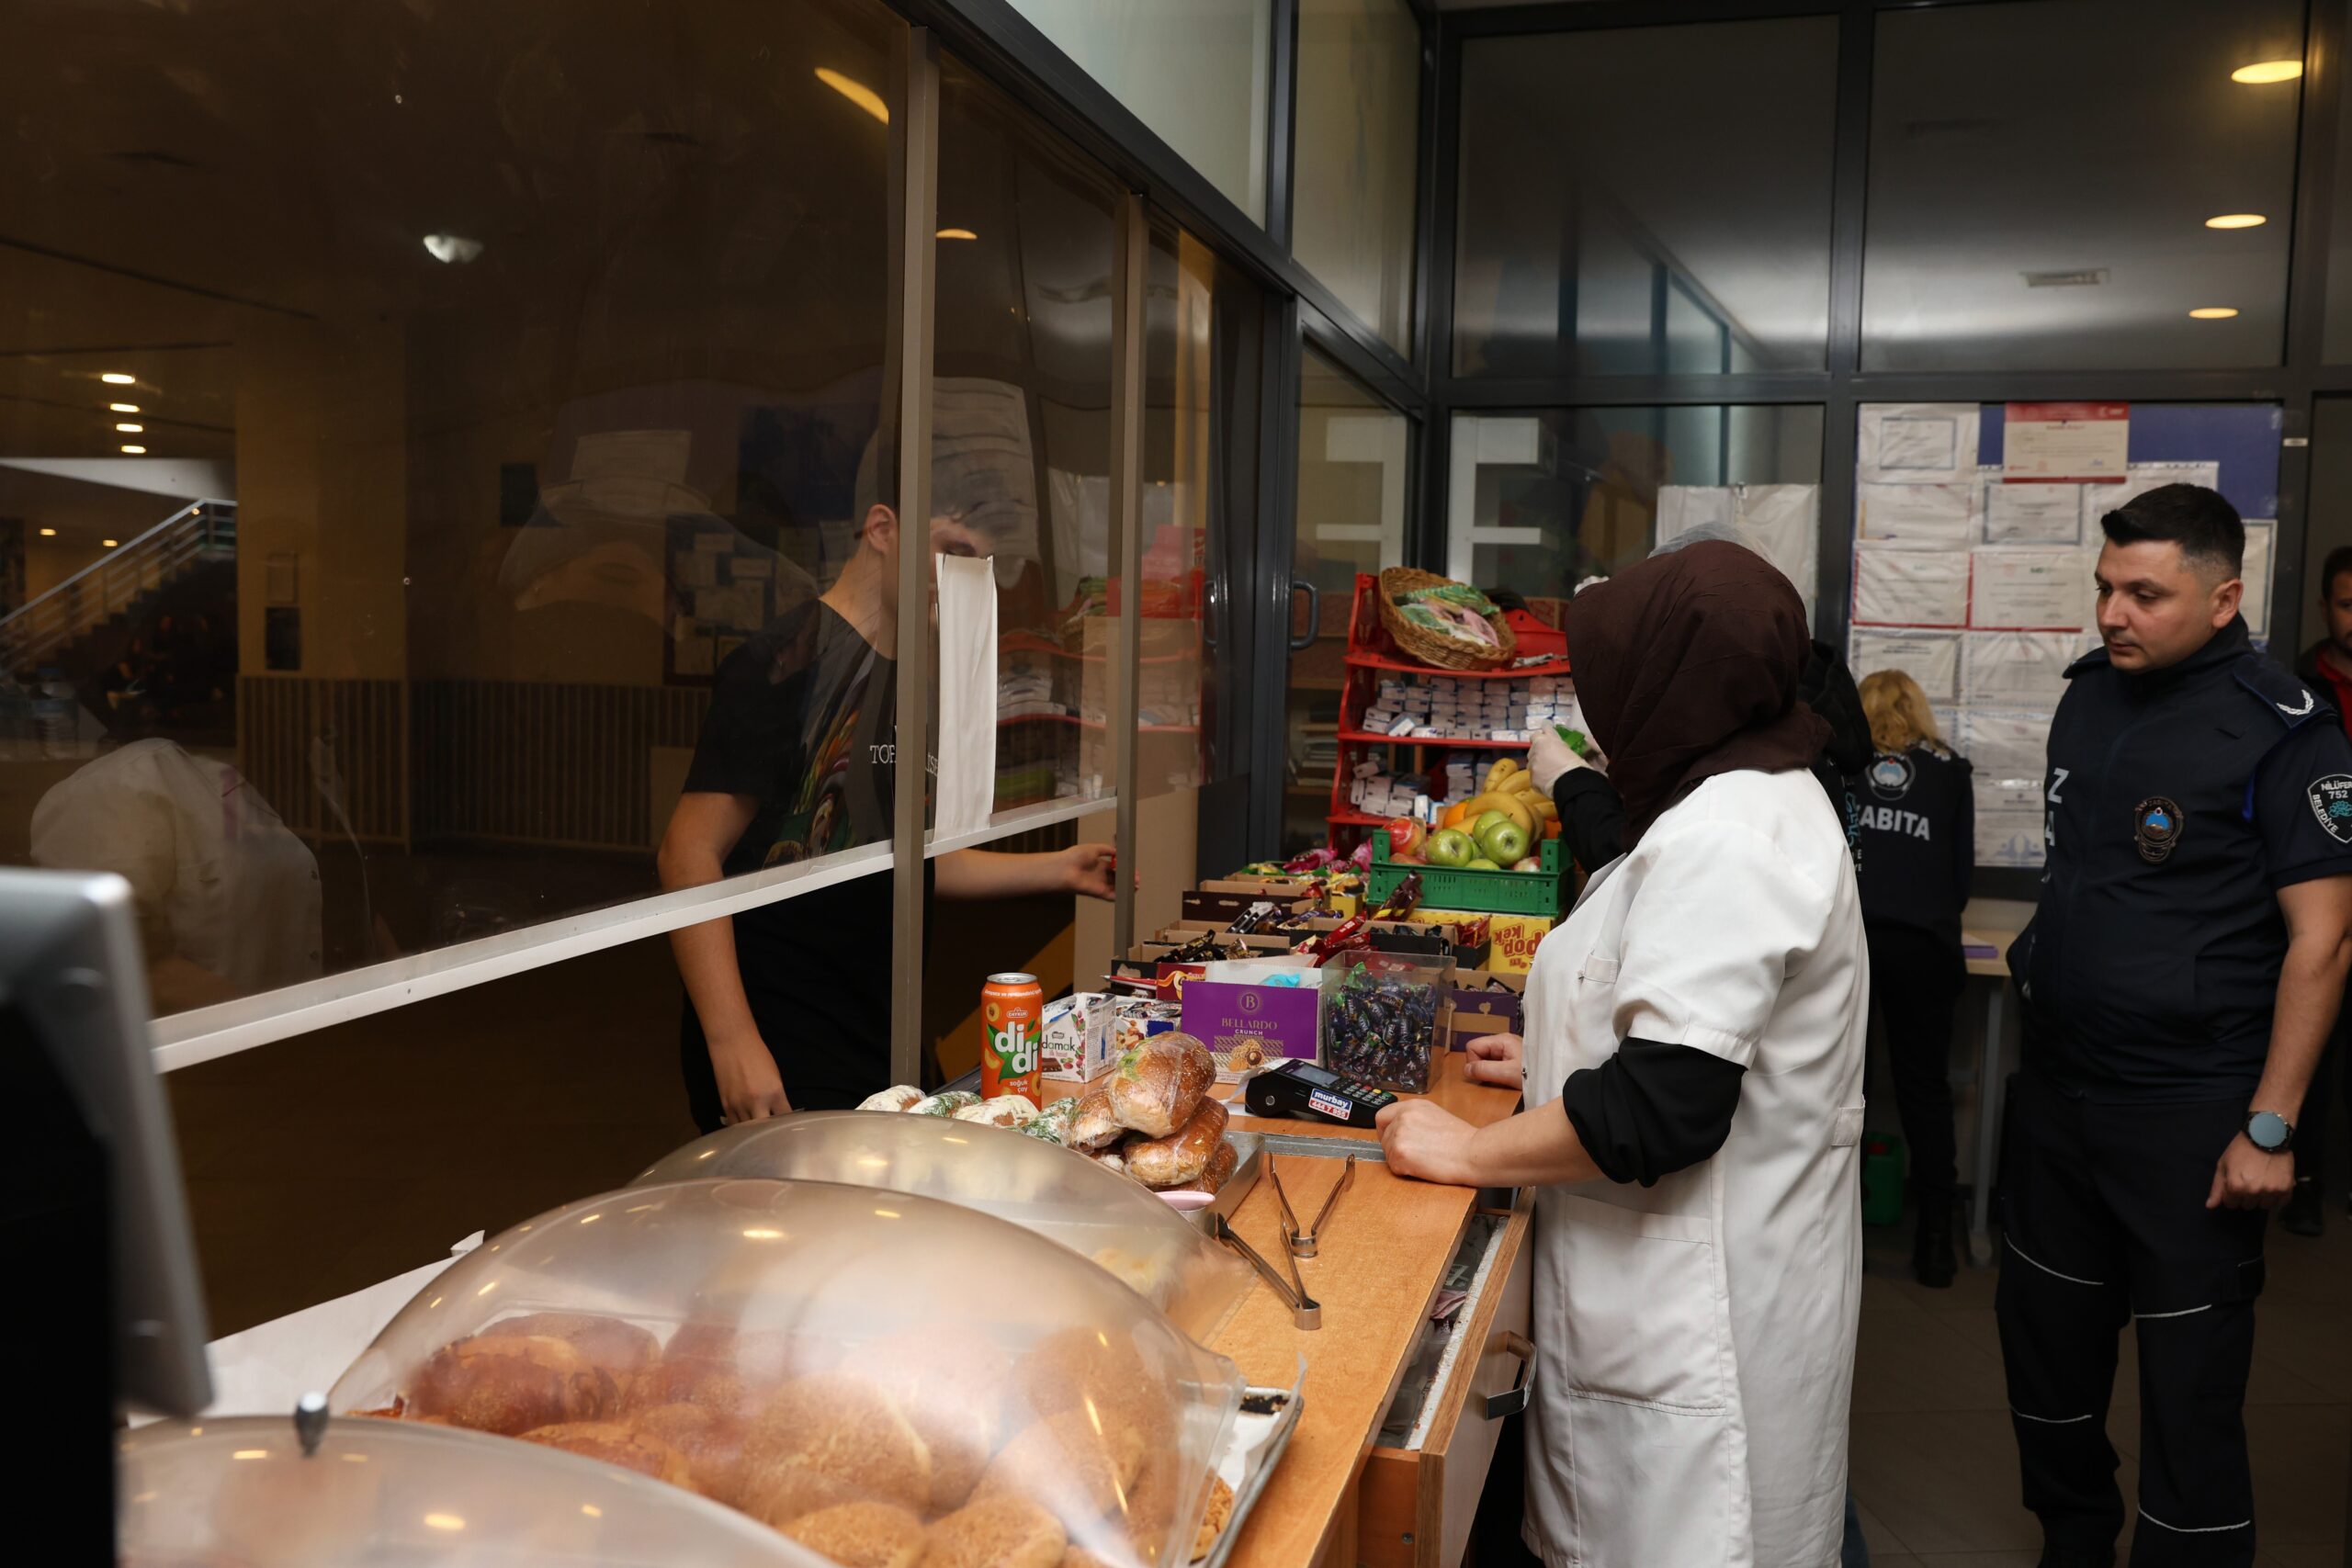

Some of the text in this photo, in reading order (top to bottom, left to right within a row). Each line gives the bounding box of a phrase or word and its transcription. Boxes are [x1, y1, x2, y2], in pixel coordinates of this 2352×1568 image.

[2327, 790, 2348, 799] 752
[2312, 794, 2339, 833] BELEDİYE
[1857, 805, 1930, 841] ABITA
[1221, 1018, 1278, 1031] BELLARDO
[1042, 1034, 1076, 1052] damak
[1010, 1079, 1028, 1088] soğuk
[1314, 1091, 1349, 1109] murbay
